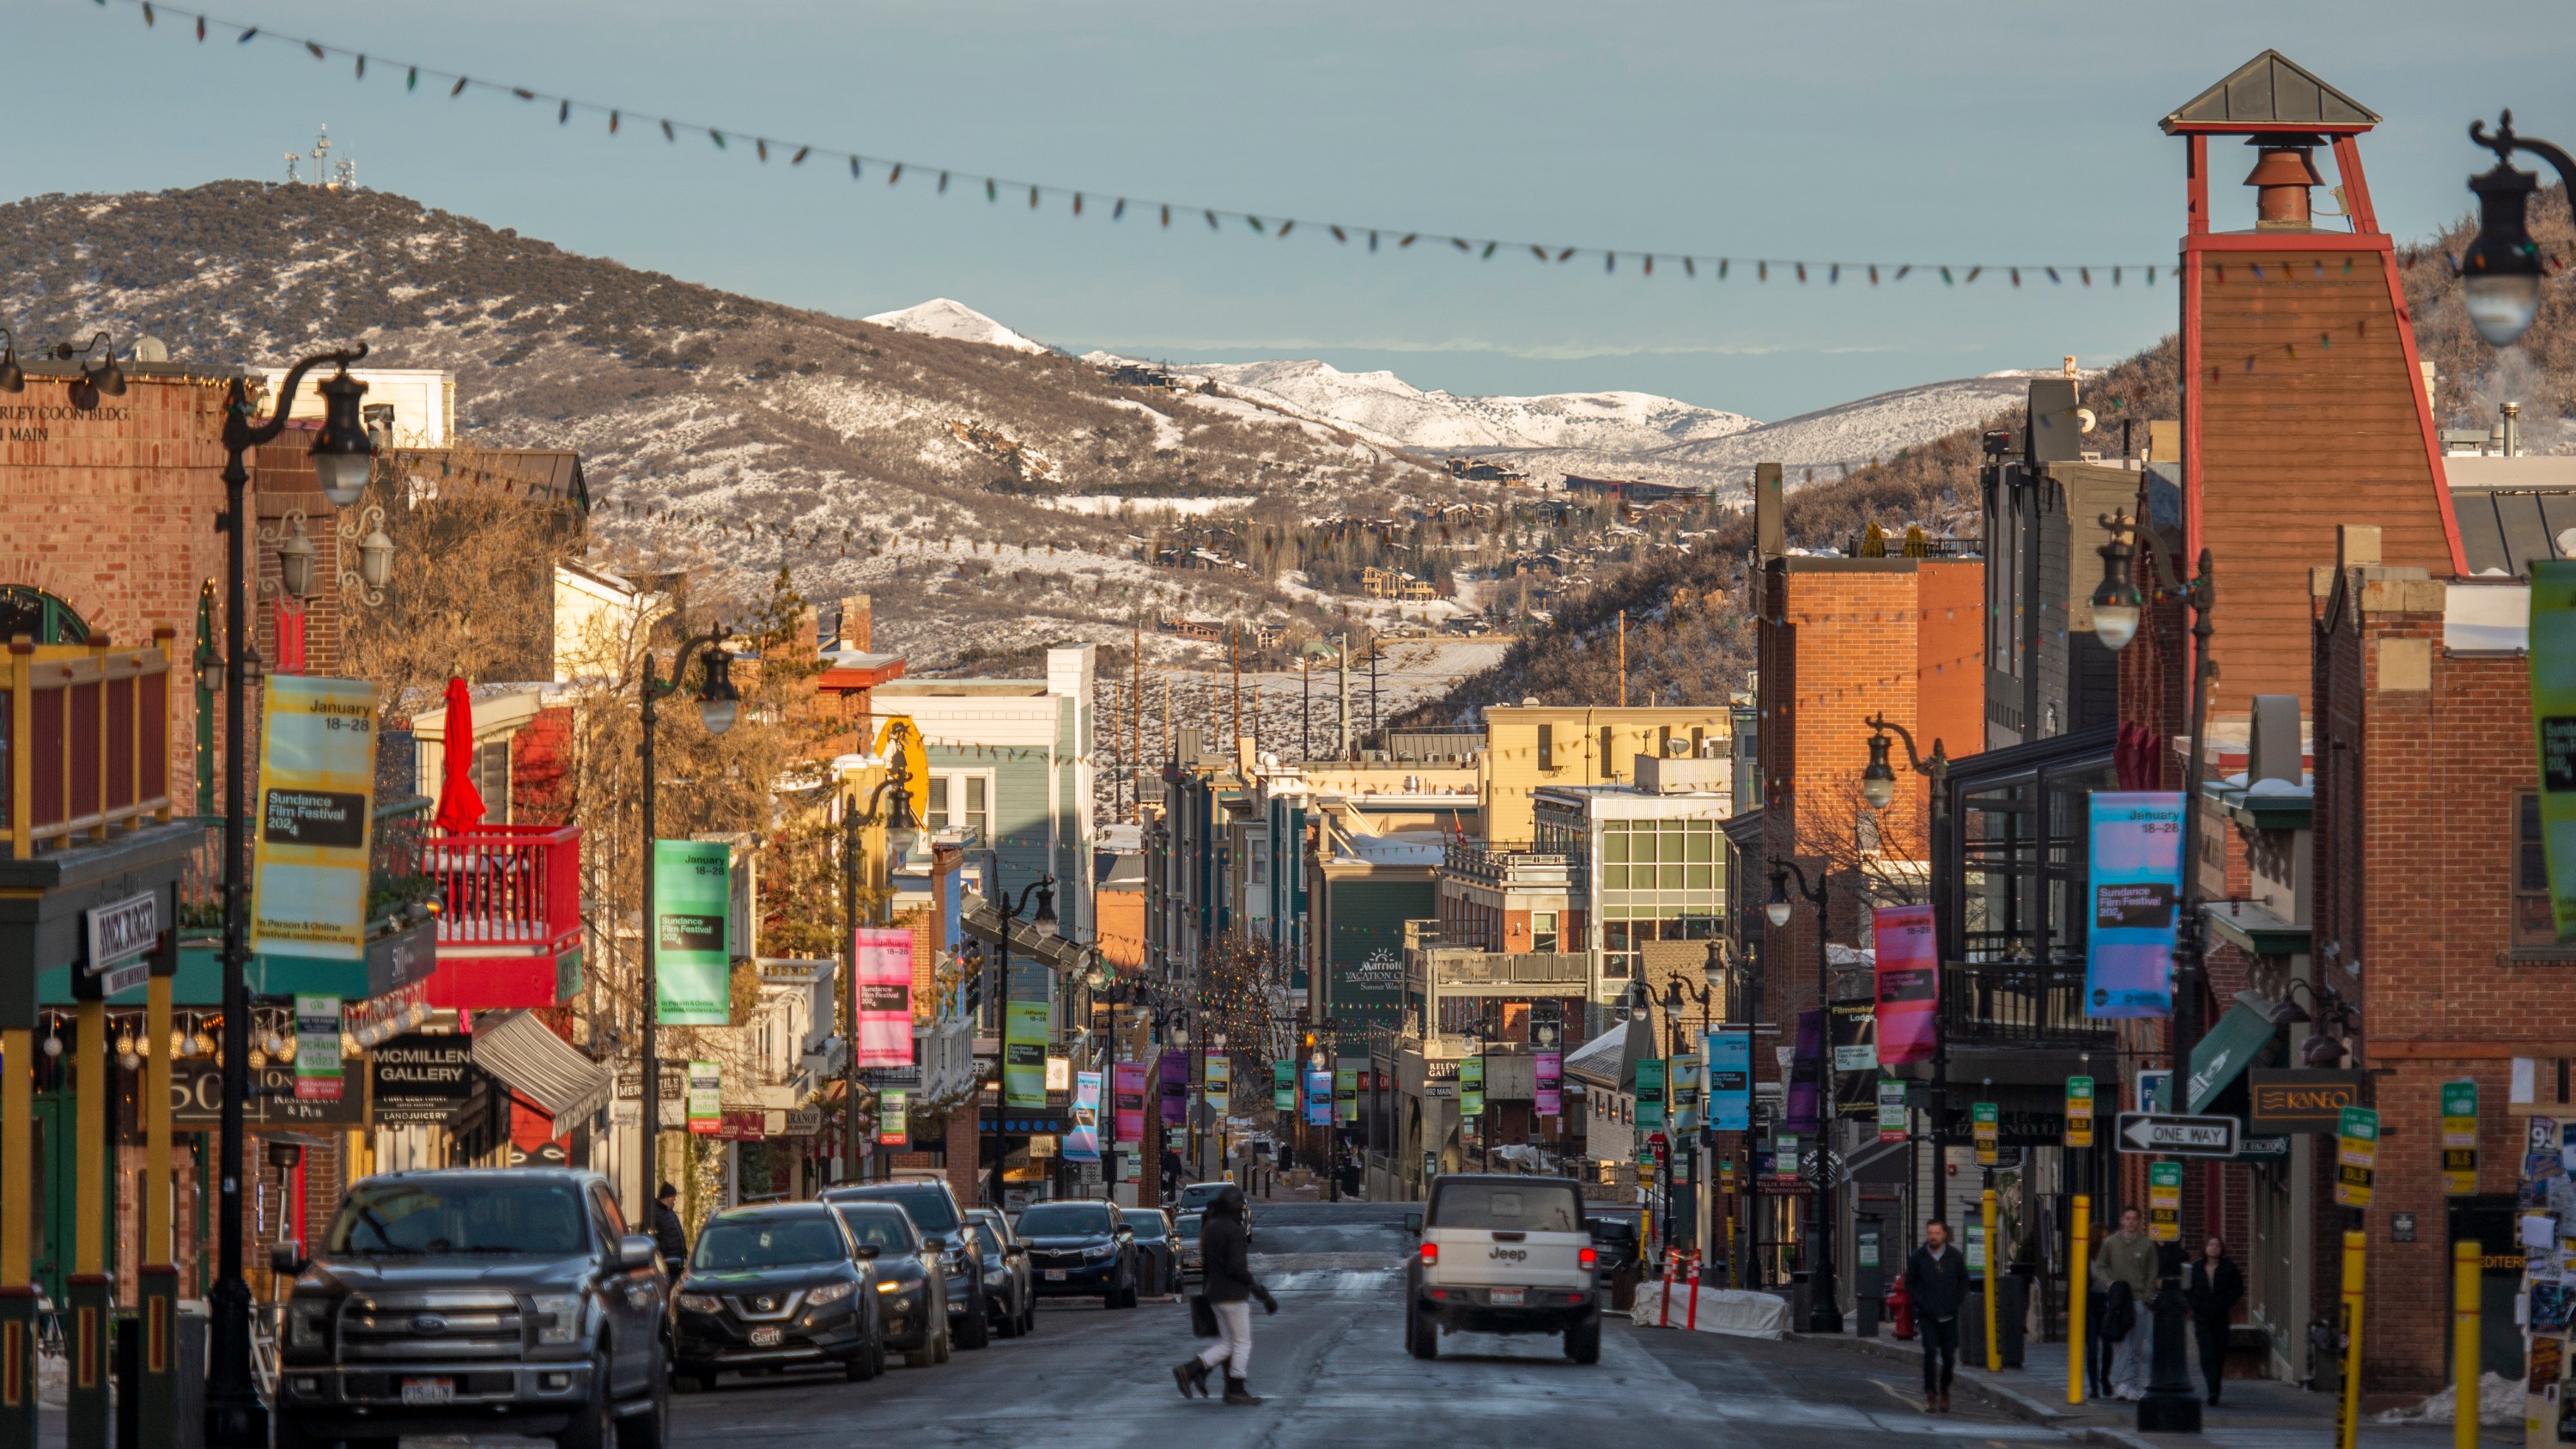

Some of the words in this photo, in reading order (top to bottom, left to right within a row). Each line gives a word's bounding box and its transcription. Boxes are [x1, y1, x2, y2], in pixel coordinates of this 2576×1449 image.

[39, 406, 84, 421] COON
[89, 407, 131, 421] BLDG.
[9, 428, 48, 441] MAIN
[310, 699, 370, 718] January
[269, 792, 331, 807] Sundance
[268, 805, 295, 817] Film
[297, 806, 344, 820] Festival
[2129, 810, 2179, 822] January
[267, 818, 298, 837] 2024
[684, 855, 725, 867] January
[2099, 887, 2150, 898] Sundance
[2099, 898, 2122, 907] Film
[2123, 896, 2161, 906] Festival
[661, 916, 702, 925] Sundance
[2099, 908, 2123, 921] 2024
[268, 920, 301, 930] Person
[311, 922, 341, 932] Online
[661, 925, 679, 934] Film
[680, 925, 712, 934] Festival
[257, 929, 355, 944] festival.sundance.org
[661, 934, 682, 945] 2024
[1346, 971, 1391, 982] VACATION
[1360, 982, 1384, 990] Summit
[860, 998, 877, 1007] 2024
[1850, 1014, 1875, 1023] Lodge
[303, 1056, 334, 1065] 25023
[372, 1050, 471, 1062] MCMILLEN
[380, 1068, 464, 1081] GALLERY
[1437, 1087, 1451, 1096] MAIN
[287, 1105, 295, 1115] &
[2154, 1126, 2185, 1142] ONE
[2190, 1128, 2223, 1143] WAY
[1489, 1246, 1527, 1262] Jeep
